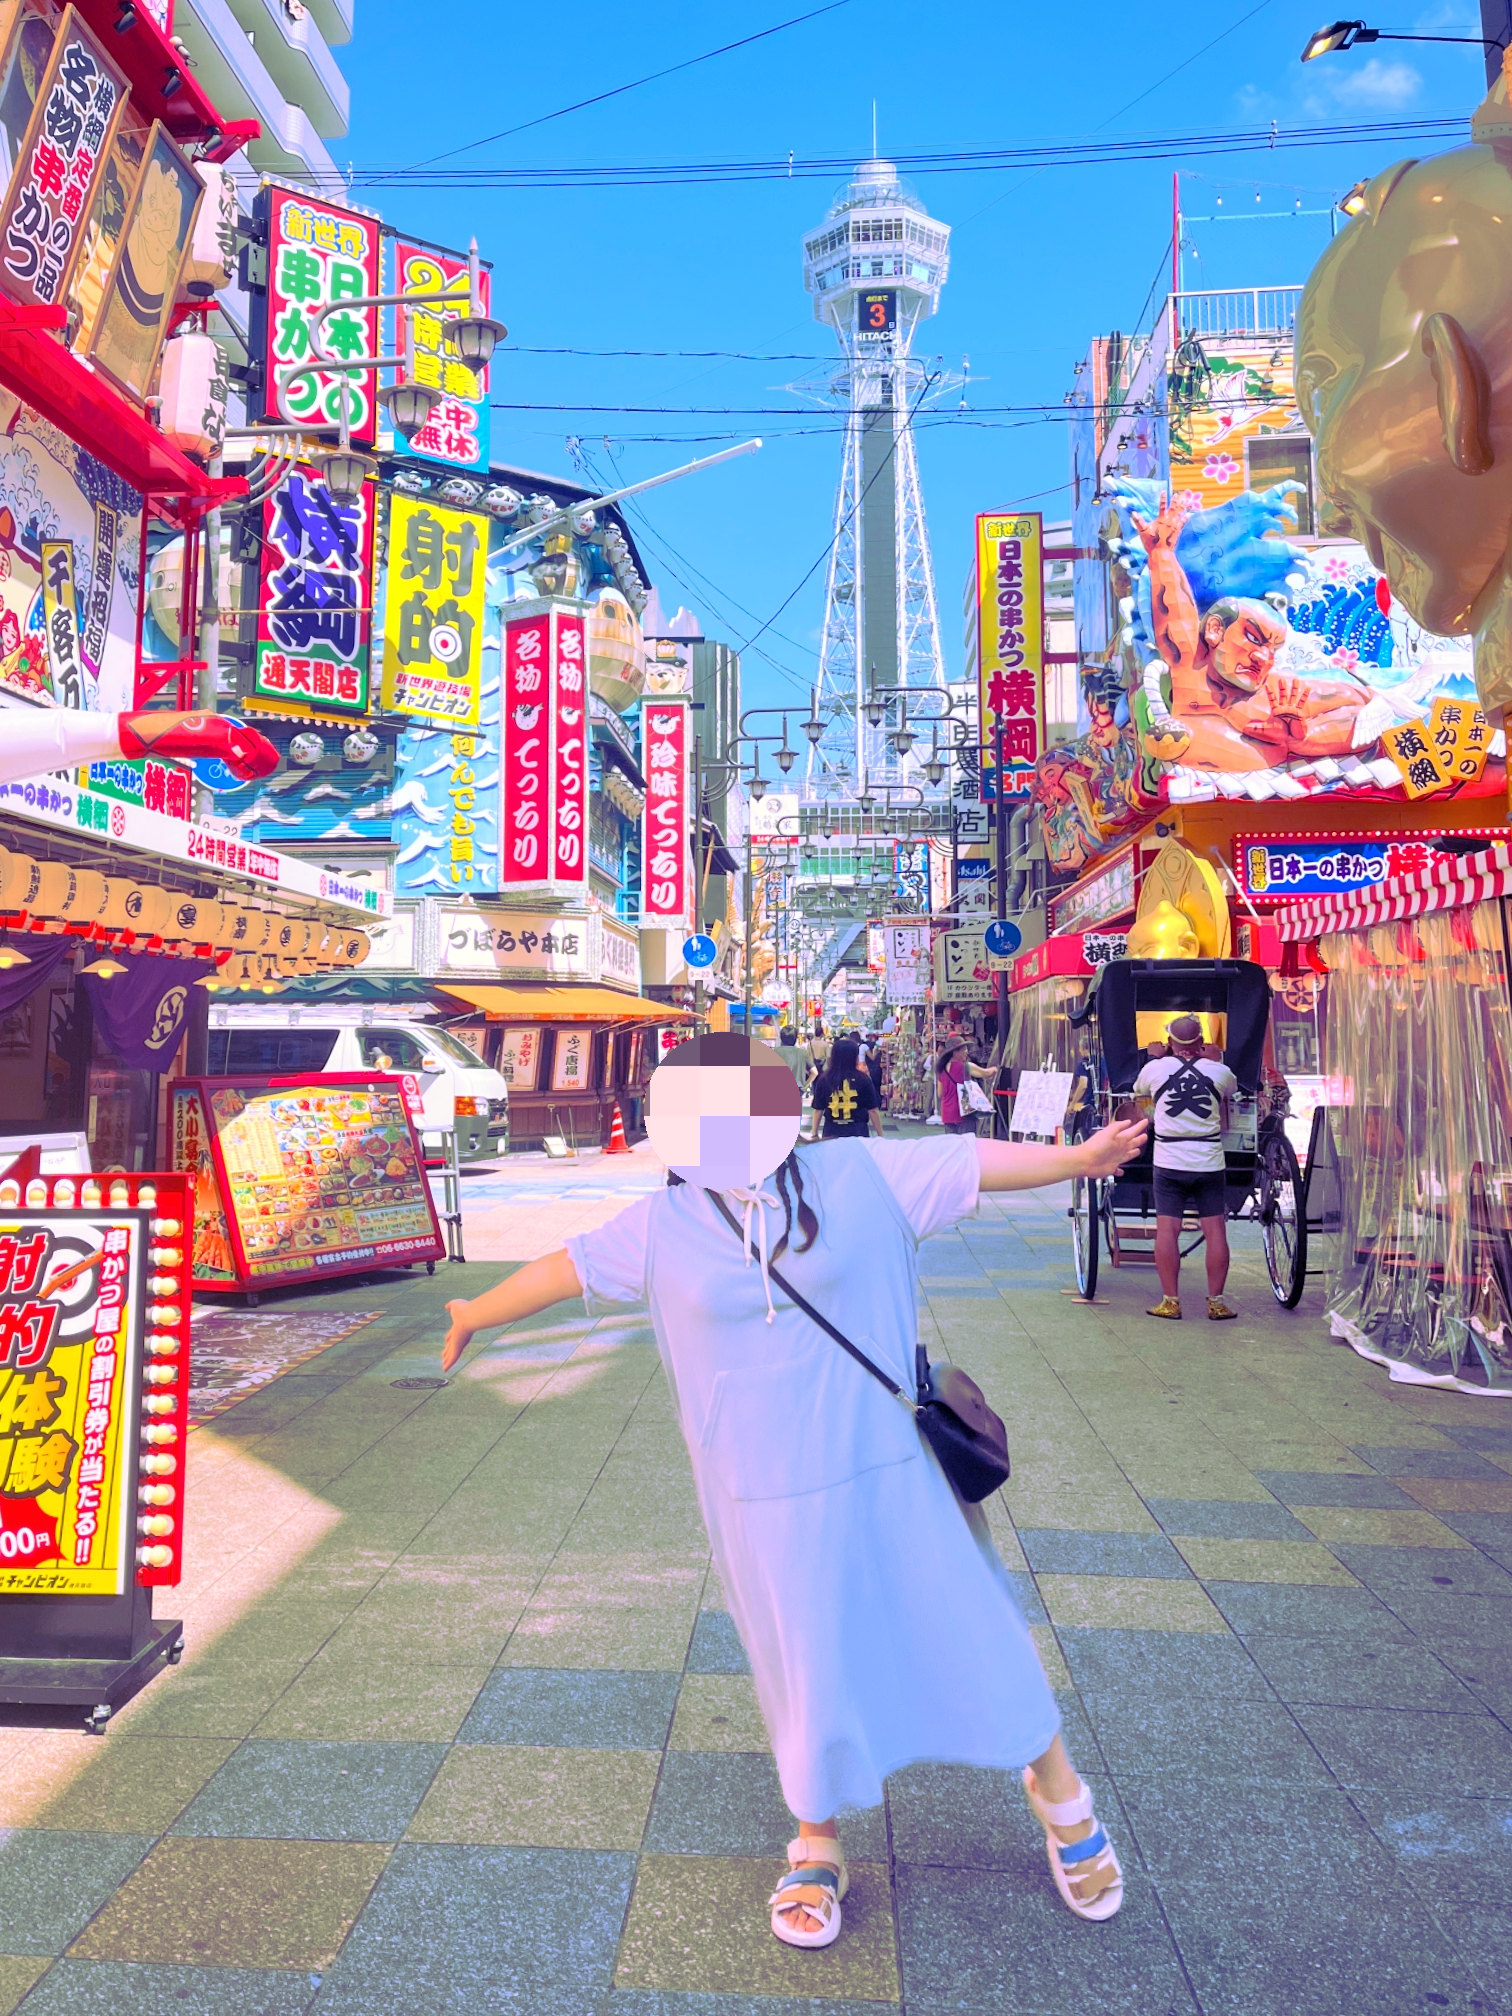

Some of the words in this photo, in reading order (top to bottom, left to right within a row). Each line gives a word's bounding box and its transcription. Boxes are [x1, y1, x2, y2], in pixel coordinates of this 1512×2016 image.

[4, 40, 98, 281] 名物串かつ
[284, 204, 366, 259] 新世界
[279, 248, 322, 417] 串かつ
[869, 303, 886, 327] 3
[412, 425, 479, 460] 無休
[987, 521, 1031, 538] 新世界
[272, 472, 366, 660] 横綱
[397, 508, 480, 679] 射的
[997, 540, 1024, 668] 日本一の串かつ
[263, 652, 360, 701] 通天閣店
[395, 672, 472, 698] 新世界遊技場
[515, 630, 543, 693] 名物
[558, 629, 582, 692] 名物
[393, 688, 474, 716] チャンピオン
[988, 669, 1038, 766] 横綱
[1394, 728, 1441, 791] 横綱
[1435, 705, 1462, 767] 串かつ
[1460, 710, 1486, 775] 日本一の
[76, 794, 109, 832] 横綱
[144, 761, 188, 821] 横綱
[449, 730, 476, 883] 何んでも旨い
[513, 738, 540, 868] てっちり
[558, 738, 582, 868] てっちり
[188, 829, 247, 871] 24時間営業
[648, 737, 679, 911] 珍味てっちり
[1250, 848, 1267, 890] 新世界
[1269, 854, 1384, 882] 日本一の串かつ
[448, 926, 580, 956] づぼらや本店
[1085, 934, 1128, 942] 日本一の串
[690, 971, 711, 979] 9-22
[518, 1032, 535, 1067] おみやげ
[564, 1034, 581, 1077] ふぐ唐揚
[74, 1228, 130, 1564] 串かつ屋の割引券が当たる!!
[6, 1574, 69, 1589] チャンピオン
